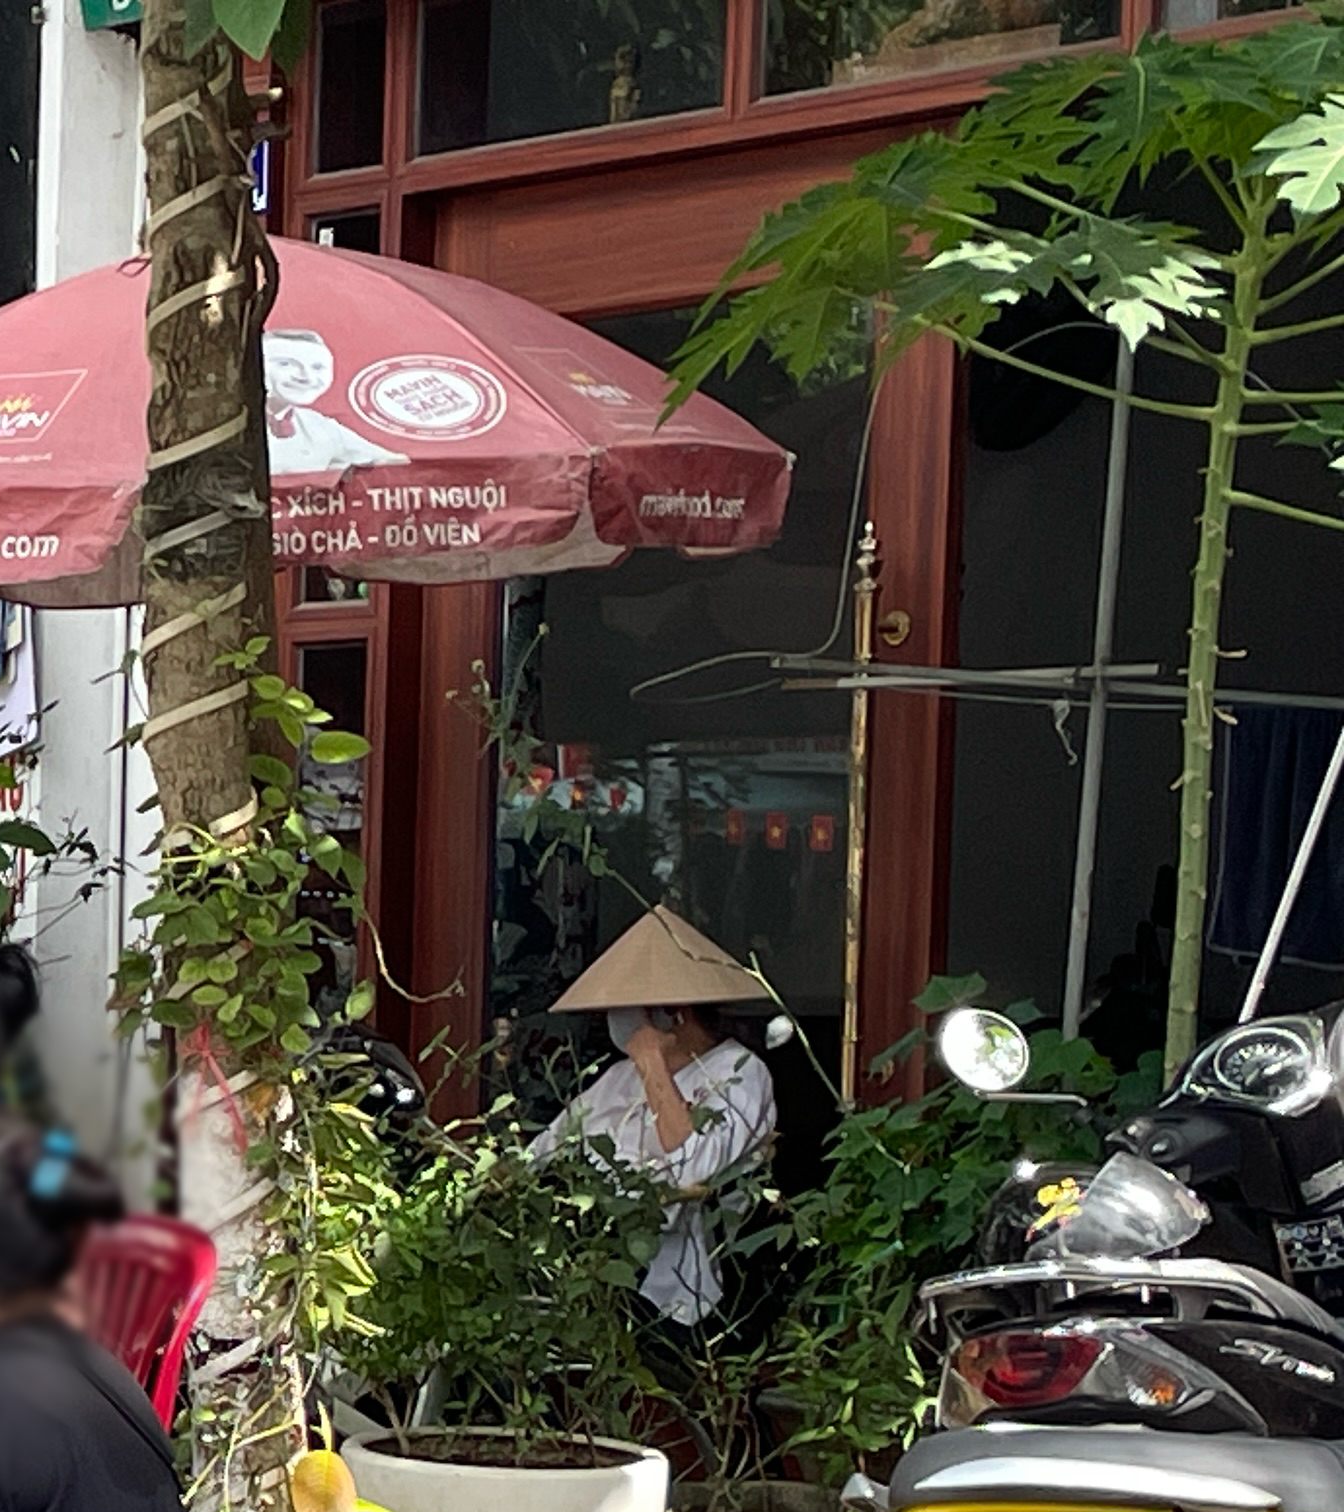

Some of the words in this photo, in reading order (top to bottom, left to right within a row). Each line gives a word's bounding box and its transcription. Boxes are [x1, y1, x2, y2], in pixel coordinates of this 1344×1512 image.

[287, 486, 346, 519] XÍCH
[367, 485, 424, 515] THỊT
[428, 478, 507, 515] NGUỘI
[311, 519, 364, 553] CHẢ
[422, 515, 482, 548] VIÊN
